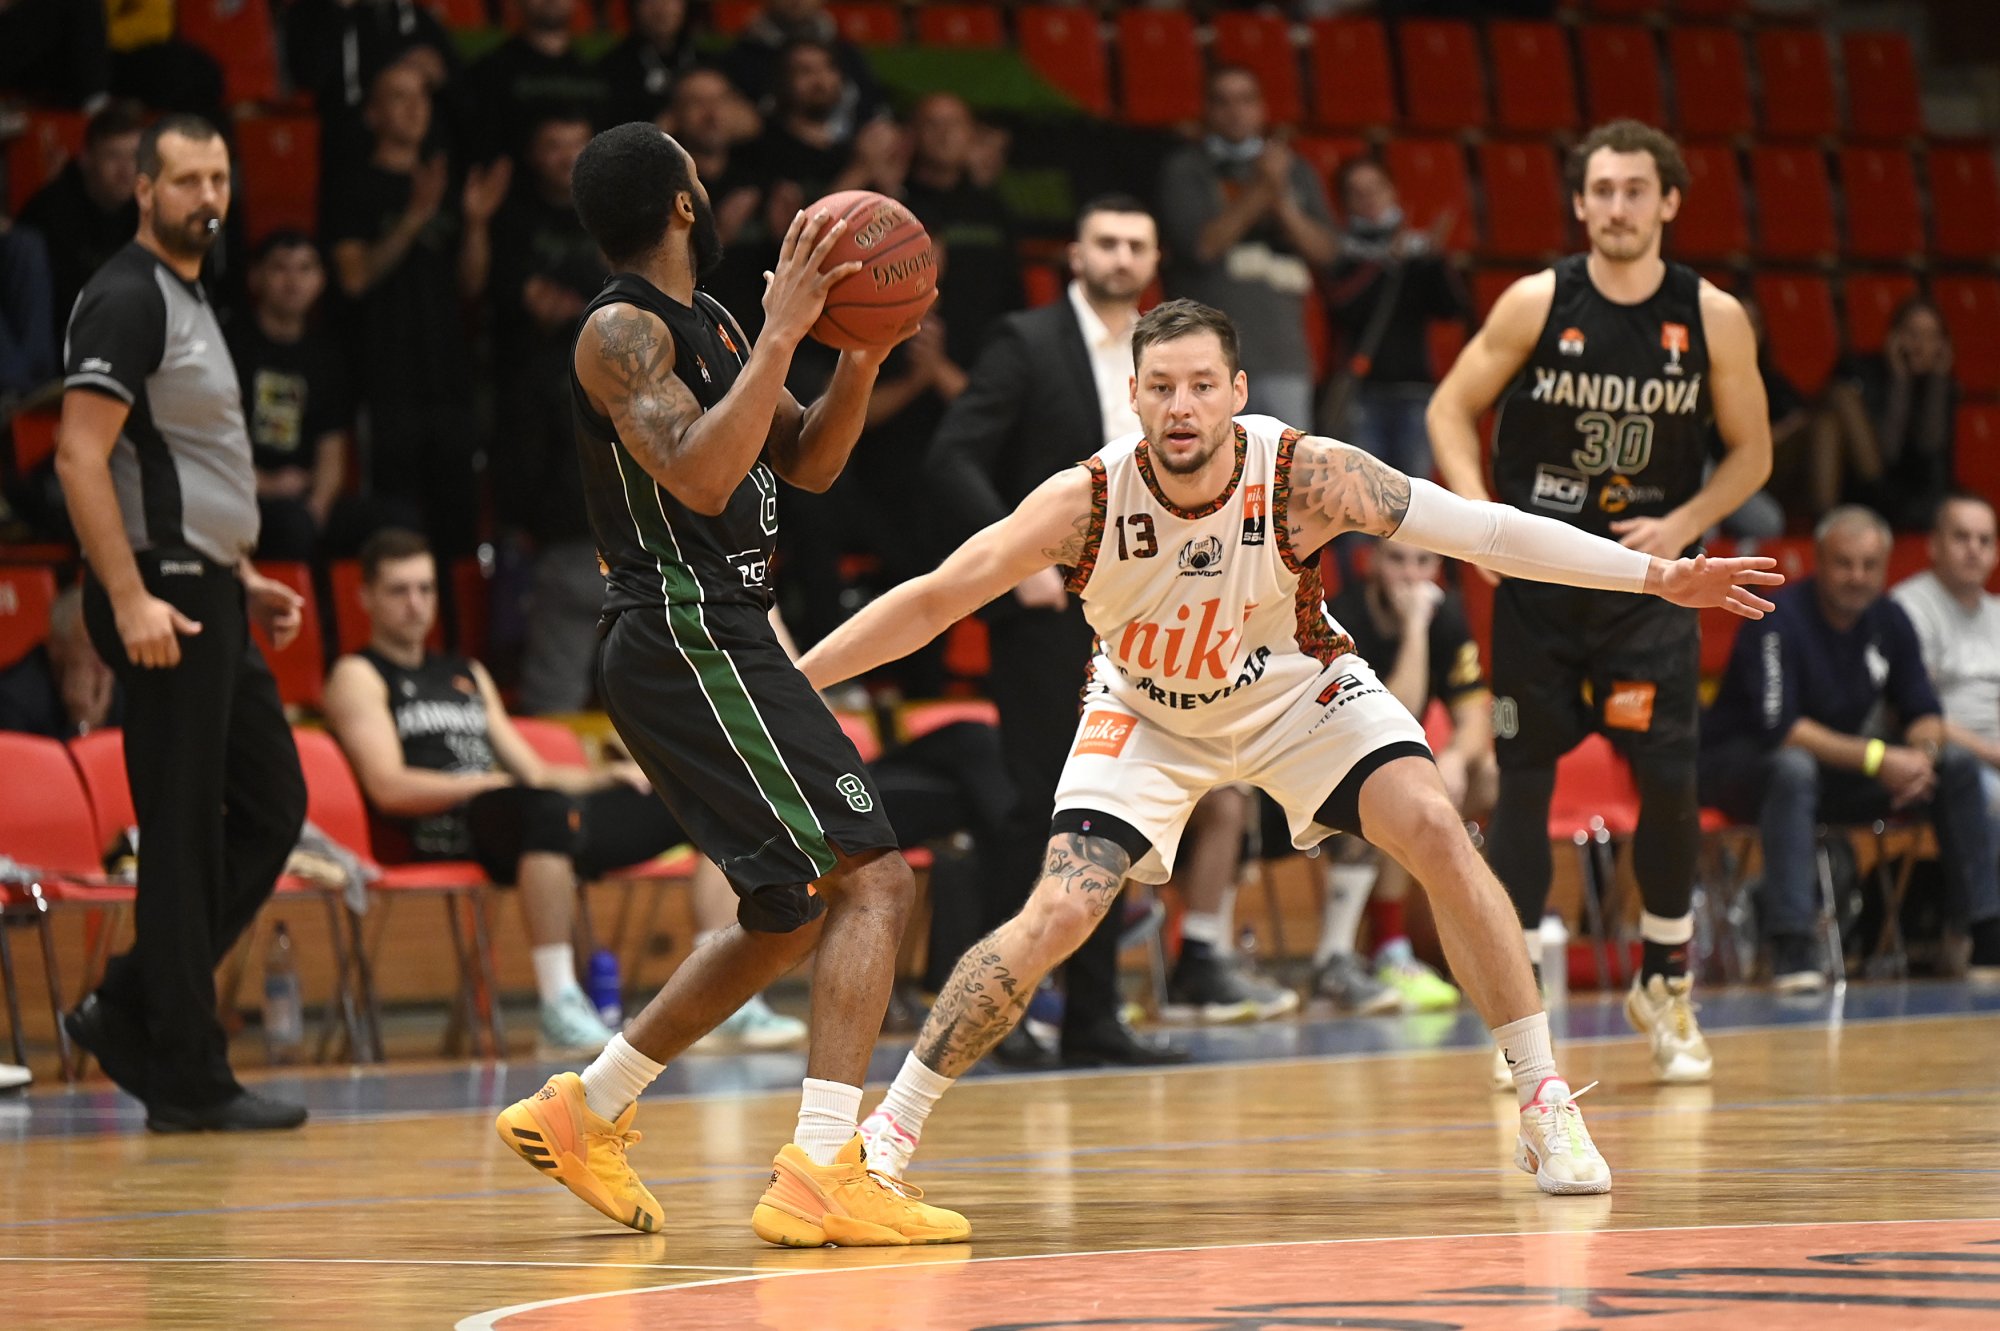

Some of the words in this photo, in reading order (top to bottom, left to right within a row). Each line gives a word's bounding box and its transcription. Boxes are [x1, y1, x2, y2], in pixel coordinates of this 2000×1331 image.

[1572, 411, 1655, 476] 30
[1115, 512, 1159, 561] 13
[836, 773, 873, 813] 8
